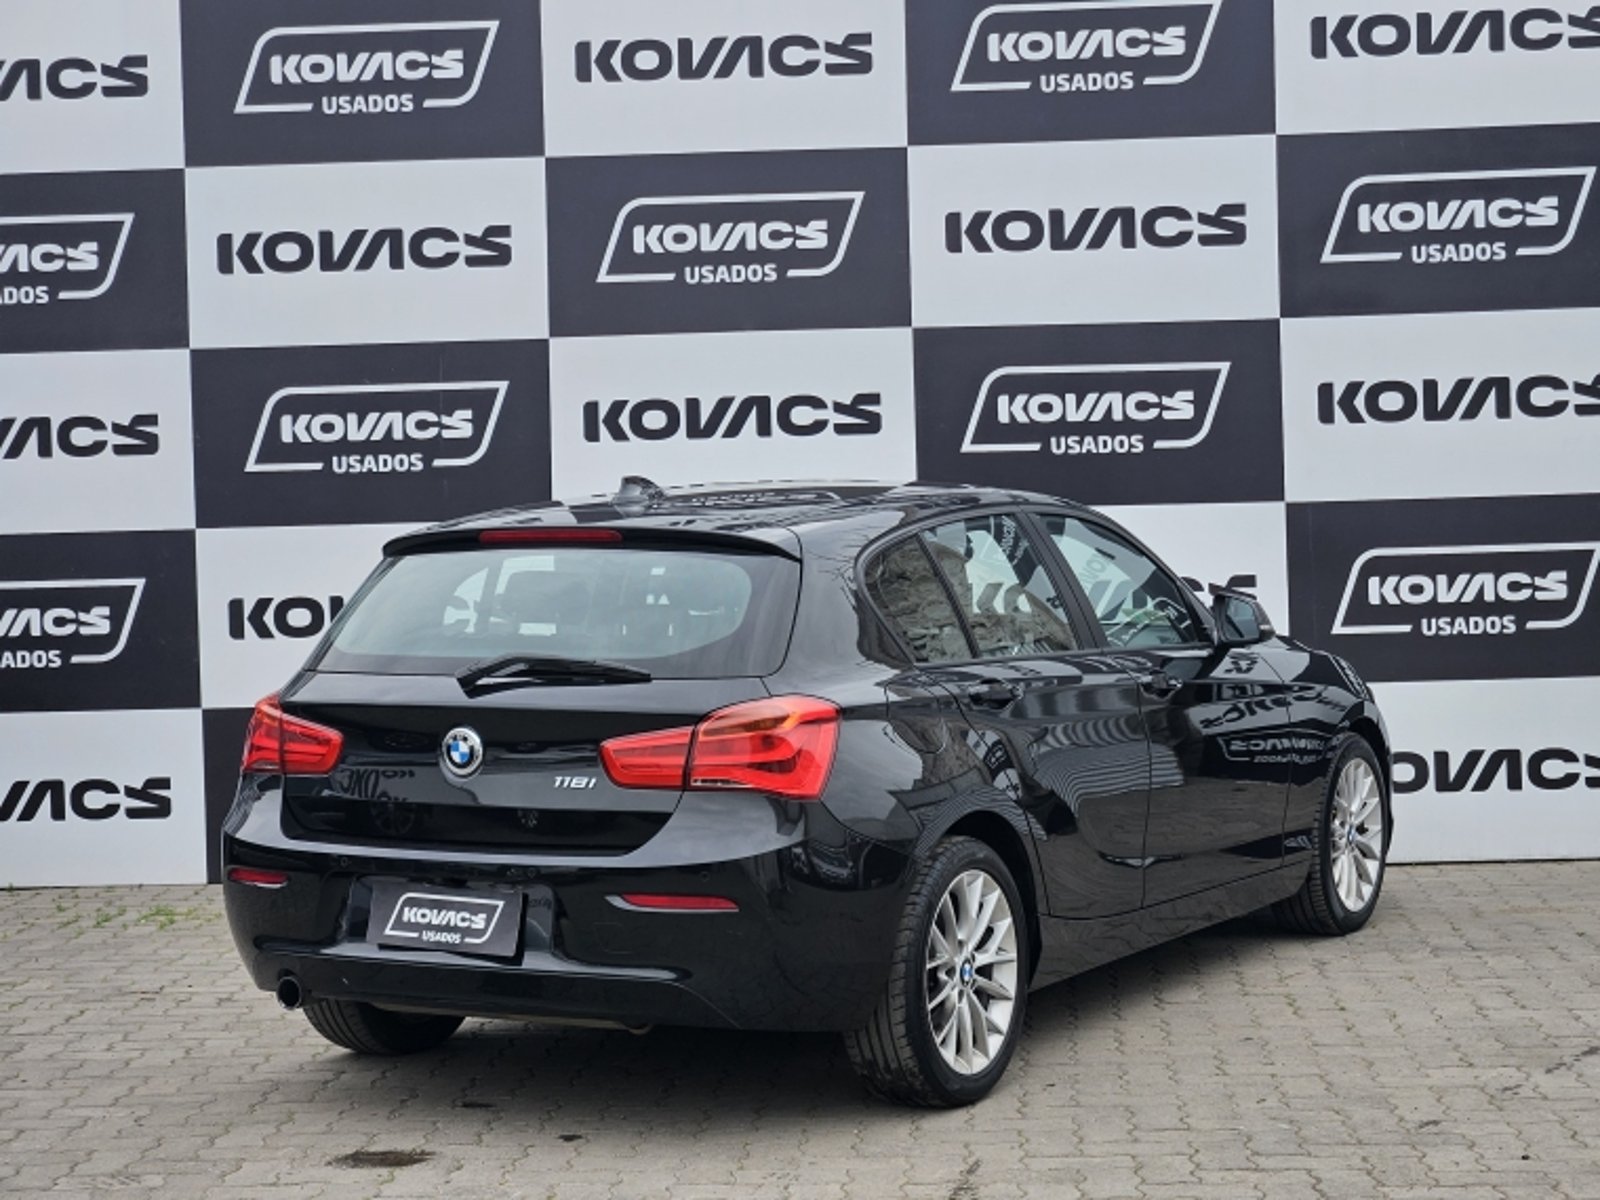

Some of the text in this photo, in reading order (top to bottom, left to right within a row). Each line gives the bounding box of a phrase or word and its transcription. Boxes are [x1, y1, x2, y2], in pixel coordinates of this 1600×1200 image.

[575, 32, 873, 83] KOVACS
[988, 26, 1186, 62] KOVACS
[0, 55, 149, 101] ACS
[270, 49, 465, 85] KOVACS
[1040, 72, 1134, 92] USADOS
[322, 94, 414, 115] USADOS
[945, 203, 1247, 253] KOVACS
[1357, 196, 1559, 233] KOVACS
[216, 225, 512, 275] KOVACS
[633, 220, 828, 254] KOVACS
[1412, 242, 1507, 263] USADOS
[0, 241, 99, 273] ACS
[685, 264, 778, 285] USADOS
[0, 285, 49, 305] DOS
[582, 393, 882, 442] KOVACS
[998, 390, 1195, 424] KOVACS
[280, 409, 474, 443] KOVACS
[1051, 435, 1144, 454] USADOS
[333, 454, 424, 473] USADOS
[1368, 571, 1568, 605] KOVACS
[1422, 615, 1517, 636] USADOS
[402, 906, 488, 930] KOVACS
[421, 930, 462, 944] USADOS
